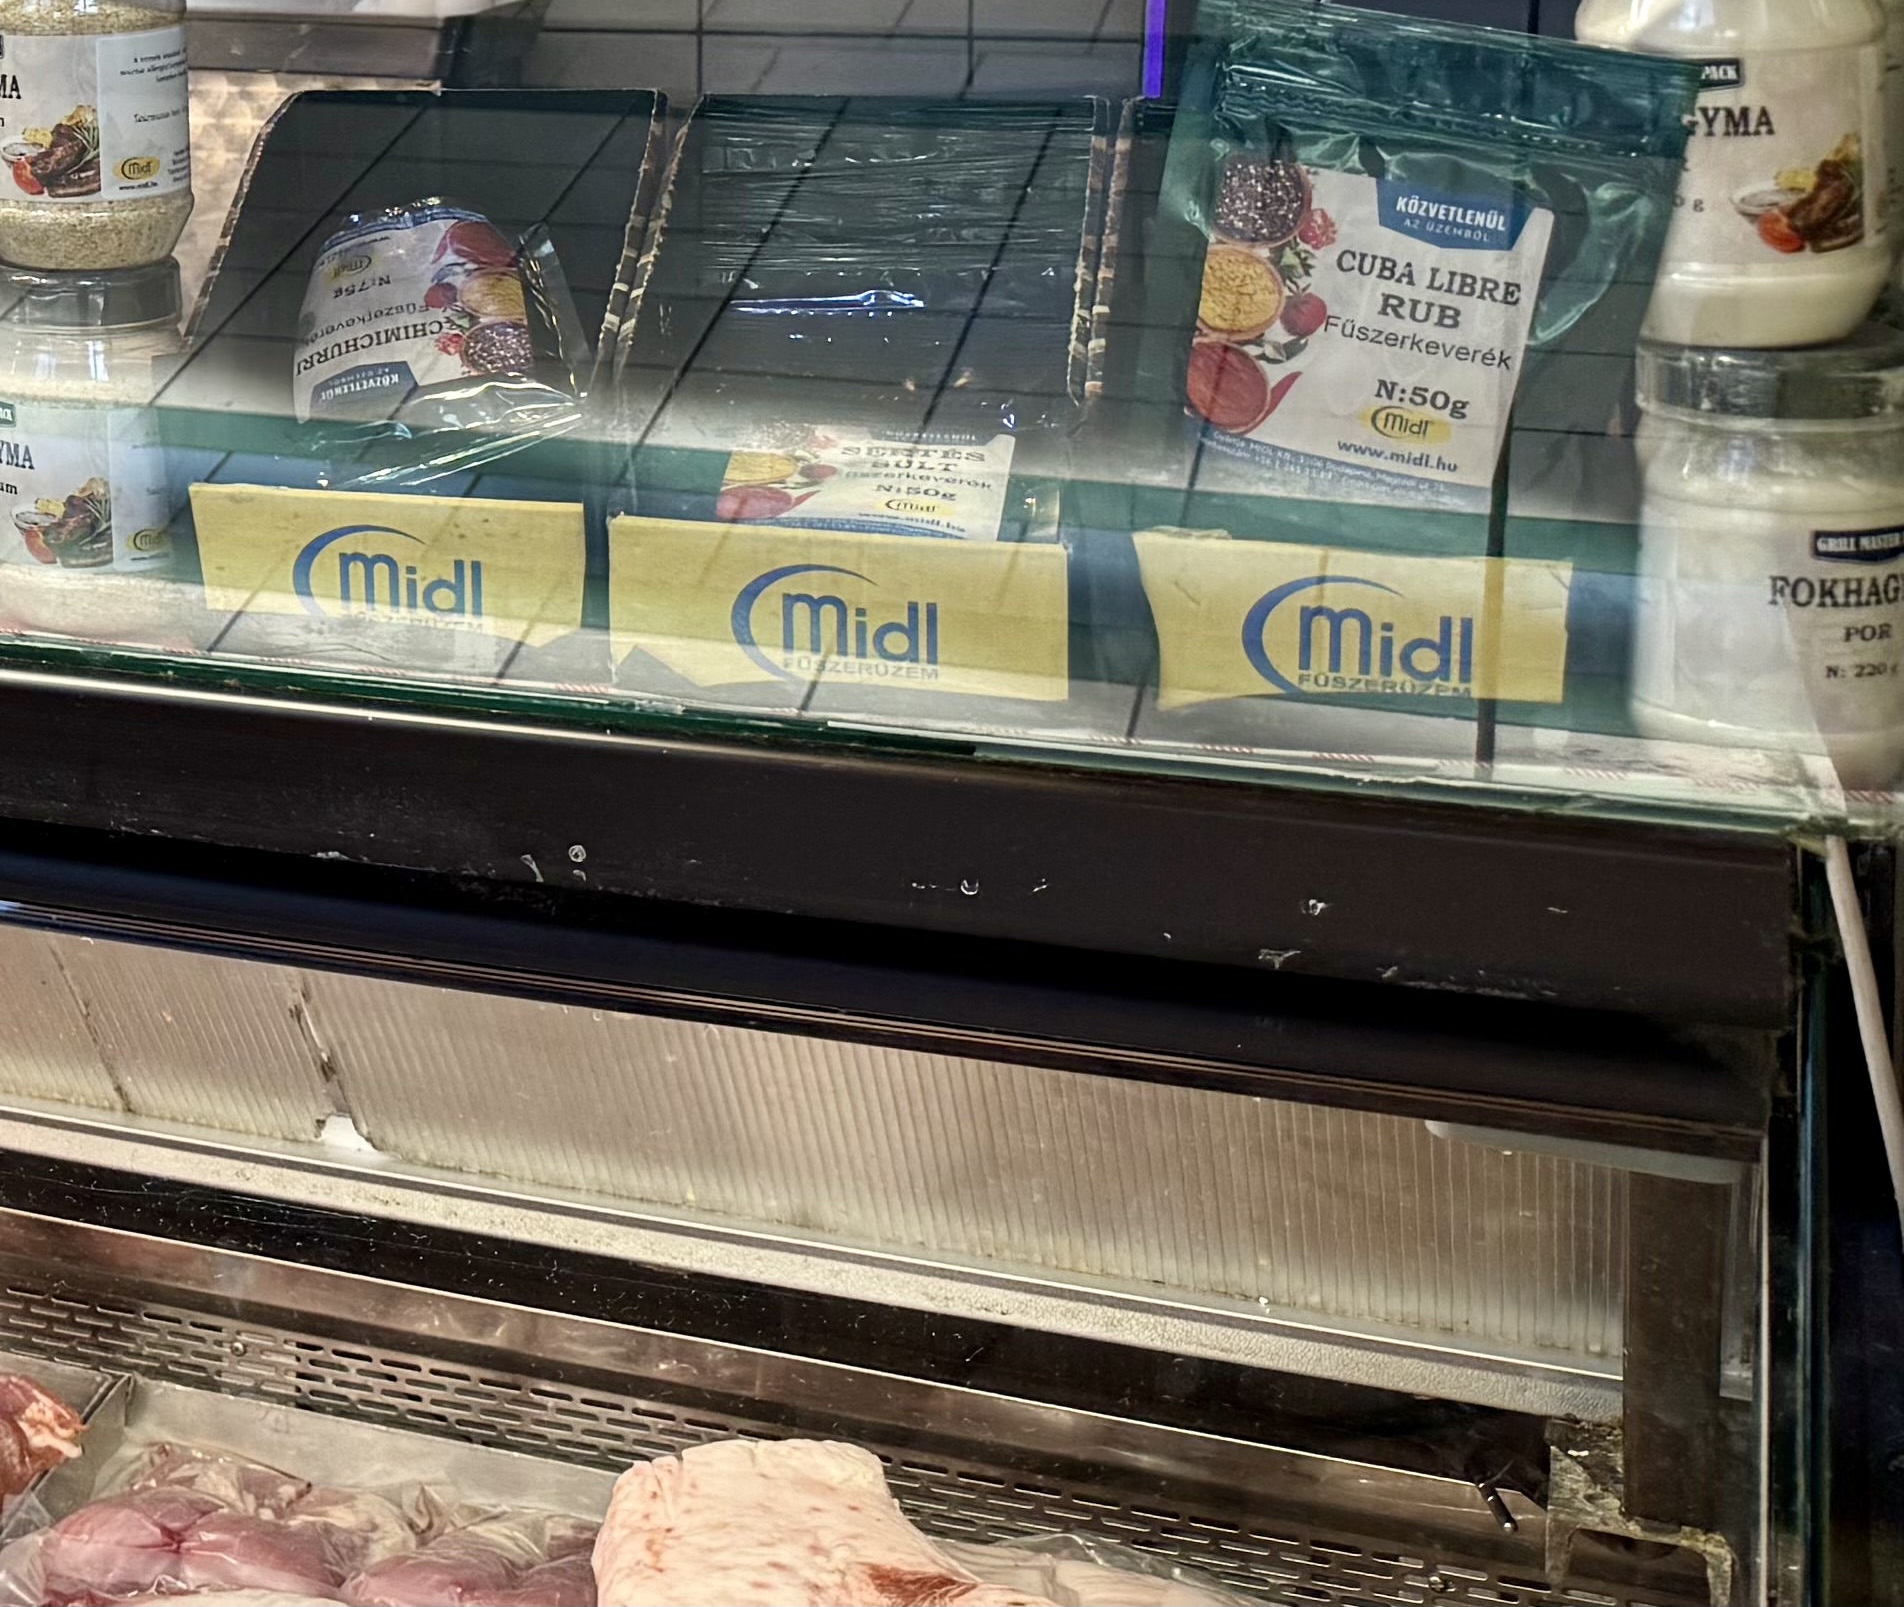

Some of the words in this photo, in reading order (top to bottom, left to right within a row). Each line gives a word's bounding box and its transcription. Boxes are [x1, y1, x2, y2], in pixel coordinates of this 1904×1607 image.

[1395, 194, 1506, 234] KÖZVETLENÜL
[1336, 249, 1416, 287] CUBA
[1426, 265, 1522, 306] LIBRE
[1378, 292, 1462, 330] RUB
[1374, 378, 1471, 420] N:50g
[1336, 438, 1458, 474] www.midl.hu
[1768, 573, 1904, 609] FOKHAG
[1842, 622, 1892, 643] POR
